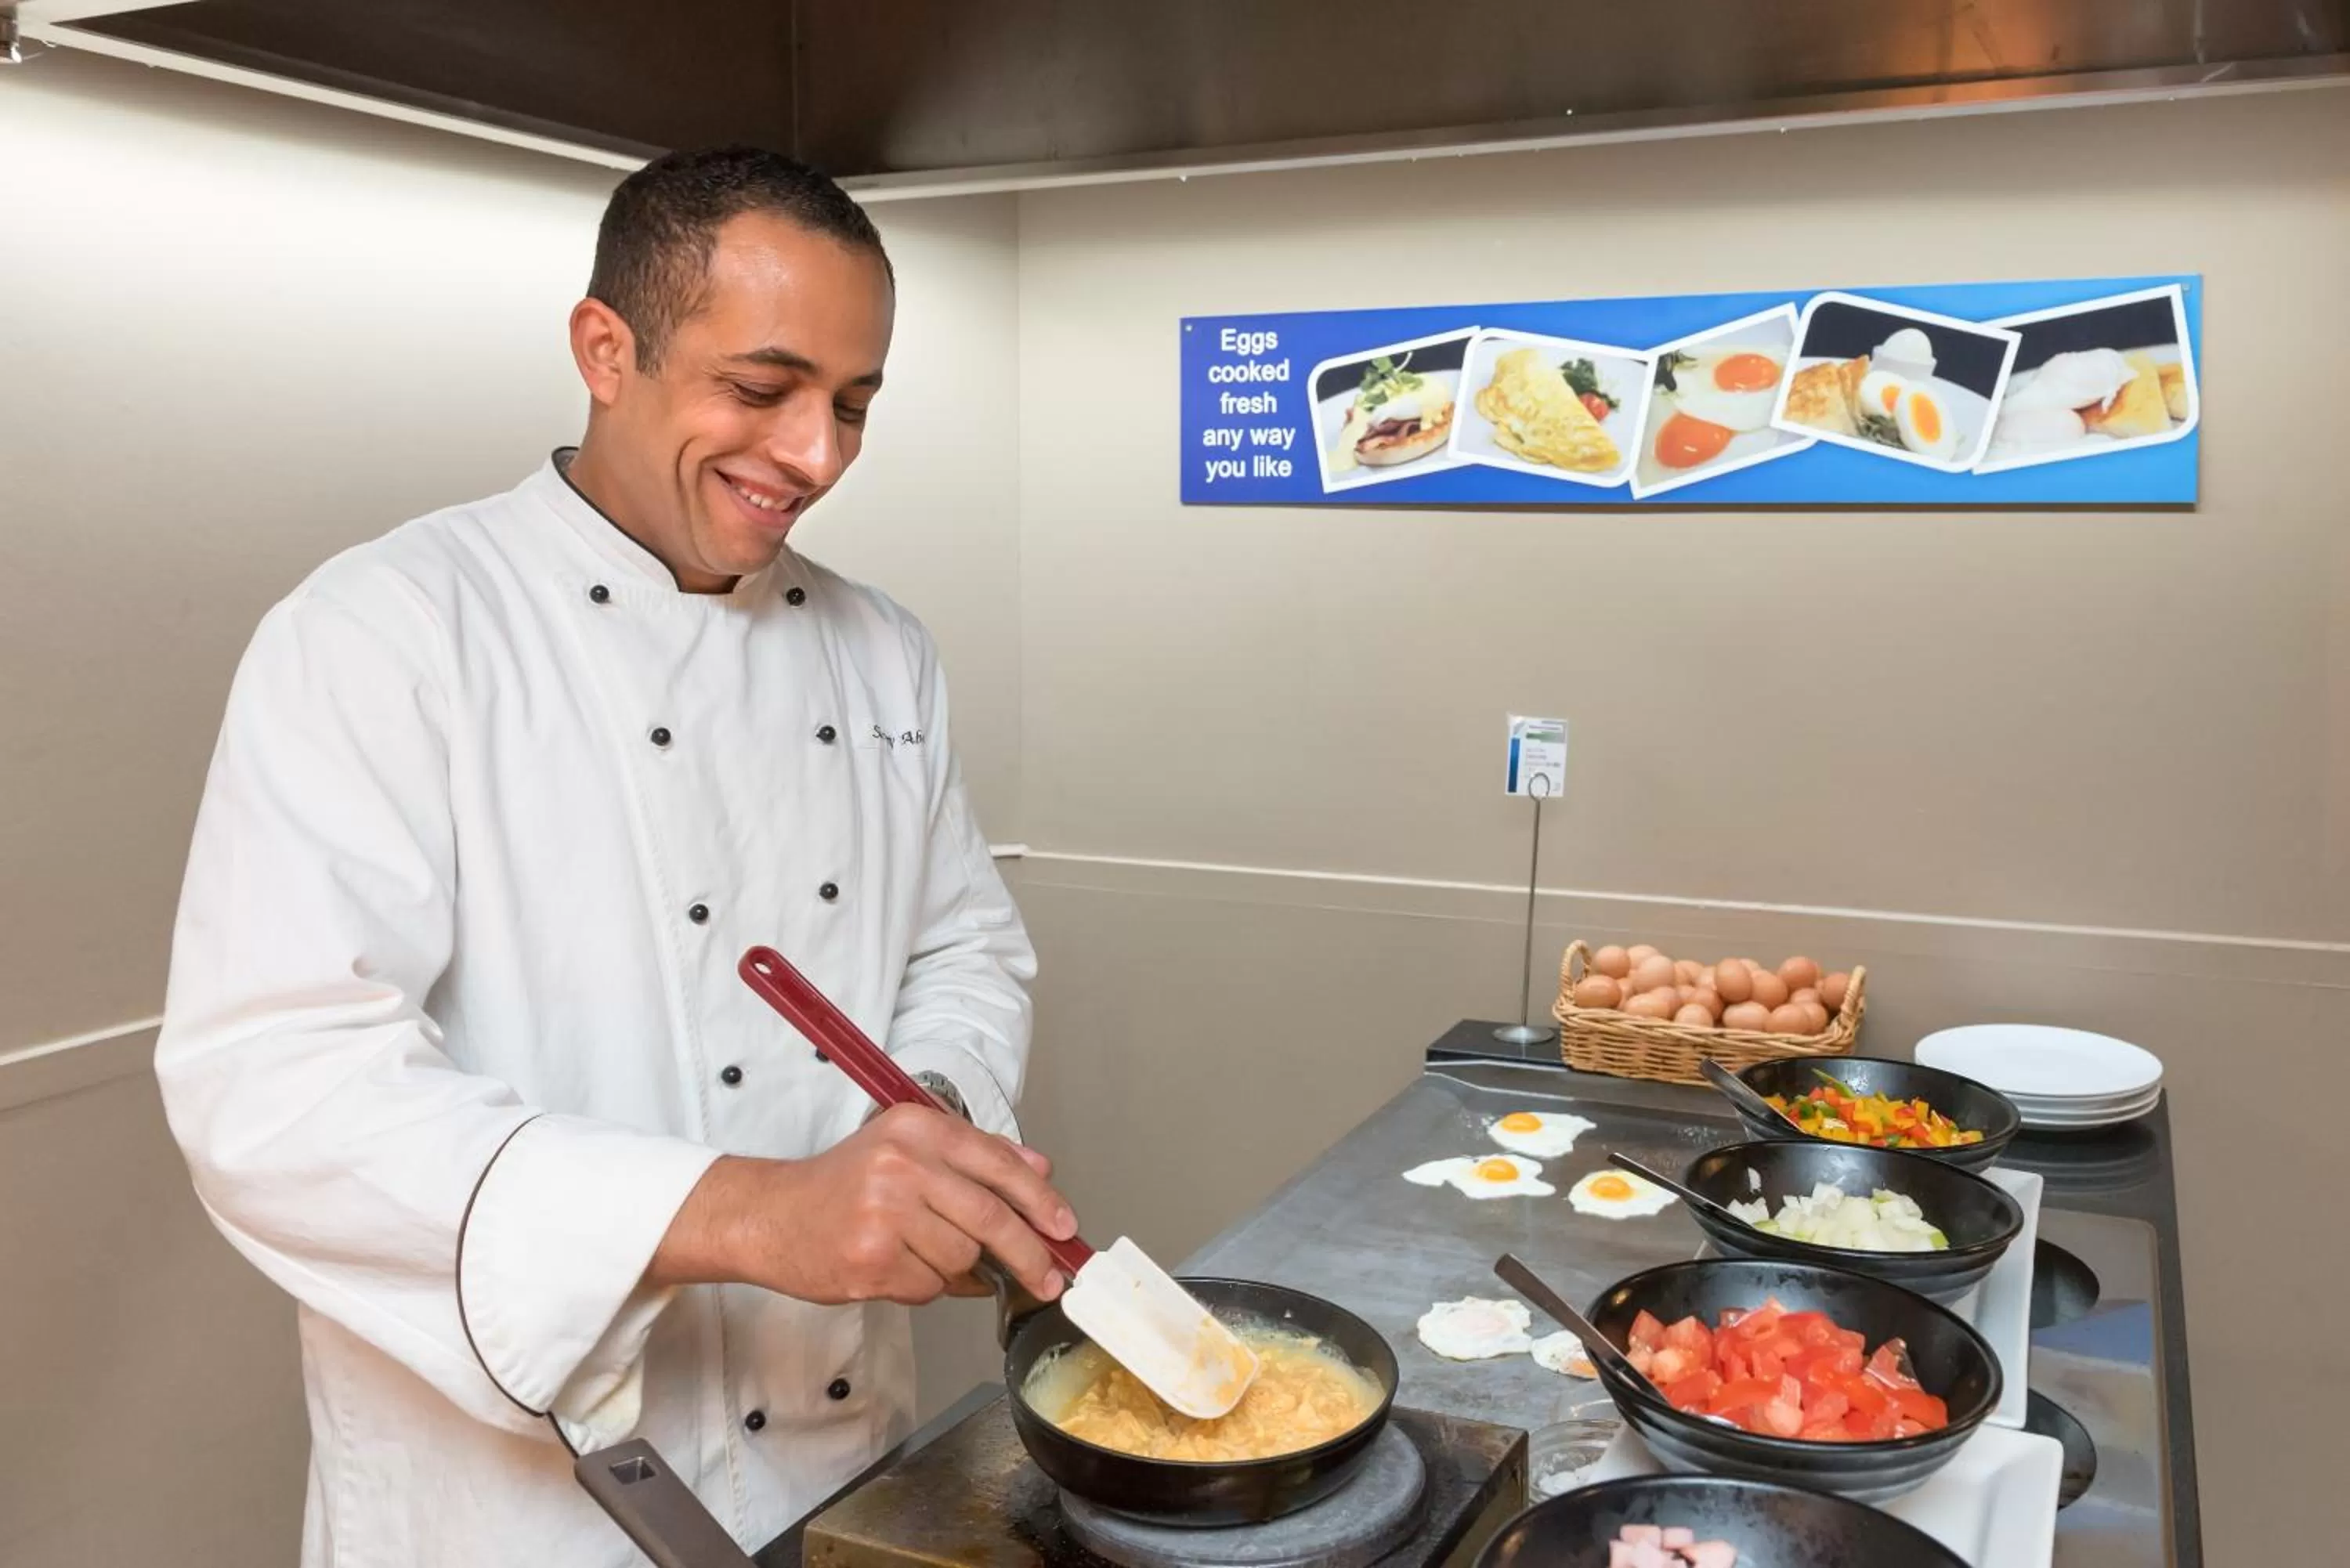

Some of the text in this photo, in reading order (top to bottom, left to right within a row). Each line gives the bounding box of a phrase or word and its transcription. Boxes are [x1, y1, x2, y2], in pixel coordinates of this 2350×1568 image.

[1220, 328, 1278, 356] Eggs
[1208, 358, 1290, 383] cooked
[1220, 392, 1278, 414] fresh
[1202, 427, 1296, 451] any way
[1205, 455, 1293, 483] you like
